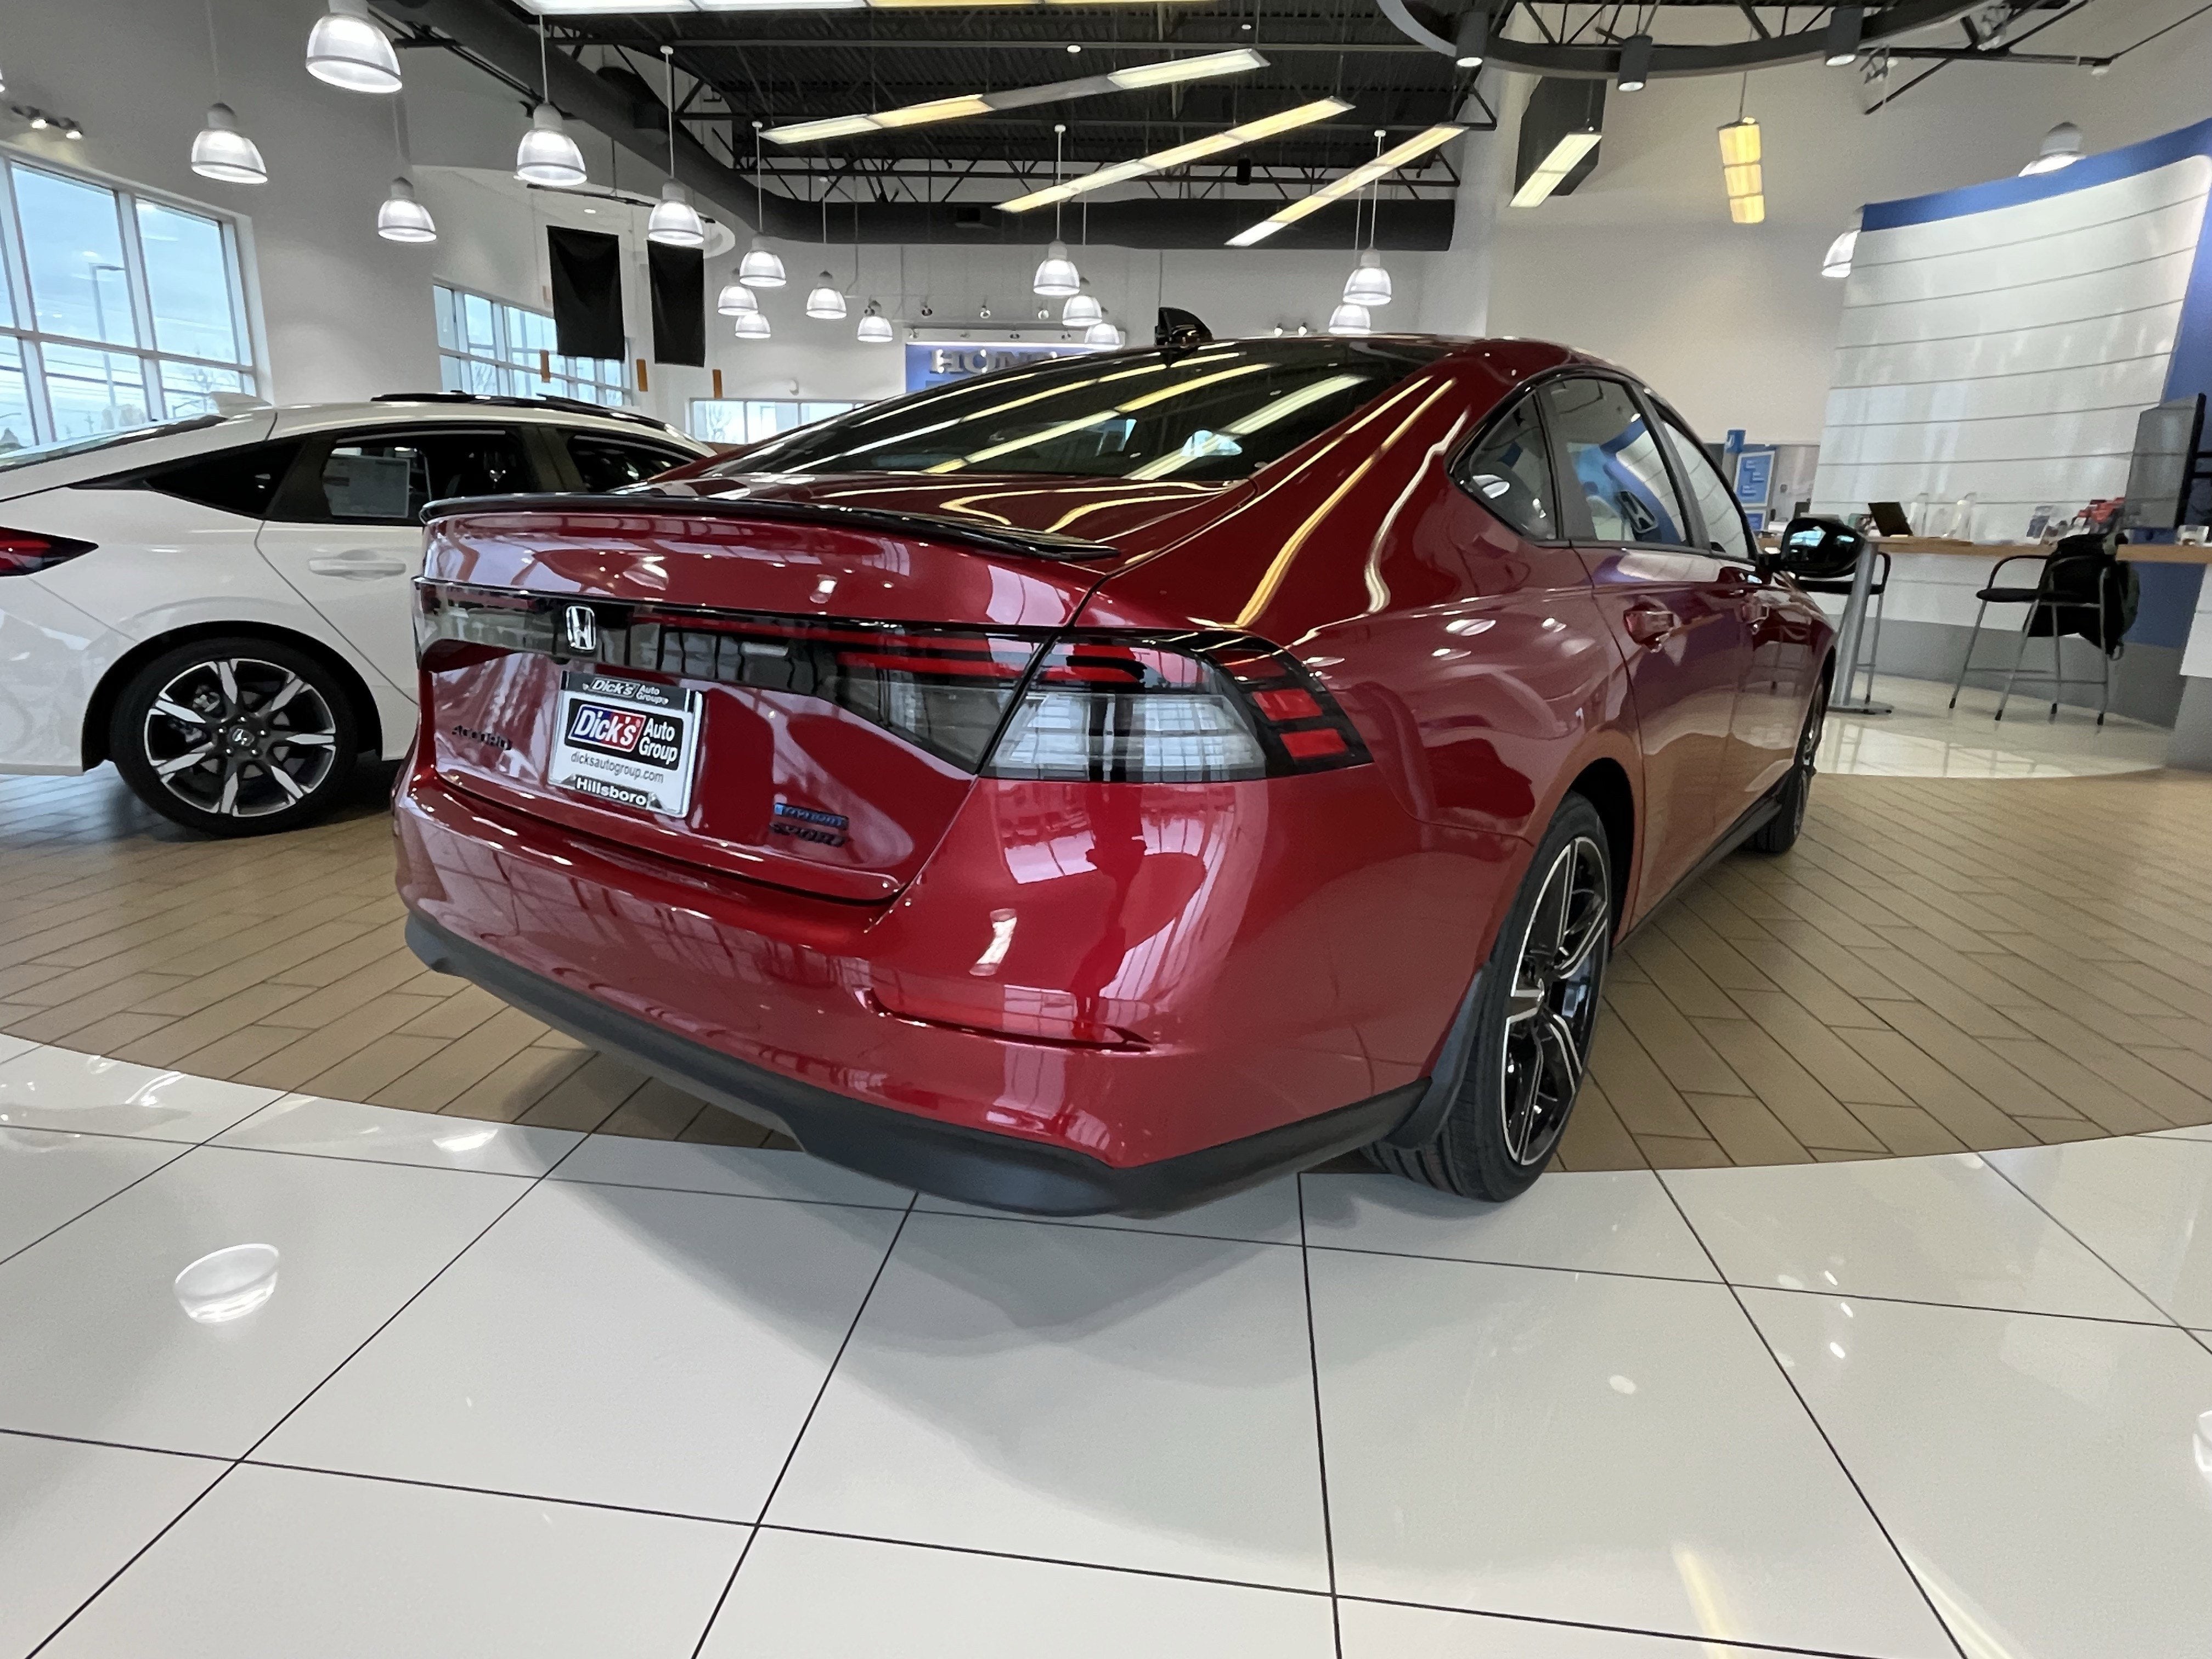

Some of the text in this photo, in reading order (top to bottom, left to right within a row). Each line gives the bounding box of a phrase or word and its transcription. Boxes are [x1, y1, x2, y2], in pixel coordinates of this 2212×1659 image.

[592, 680, 660, 696] Dick's Auto
[574, 709, 675, 746] Dick's Auto
[638, 738, 678, 765] Group
[571, 752, 664, 784] dicksautogroup.com
[576, 776, 647, 806] Hillsboro
